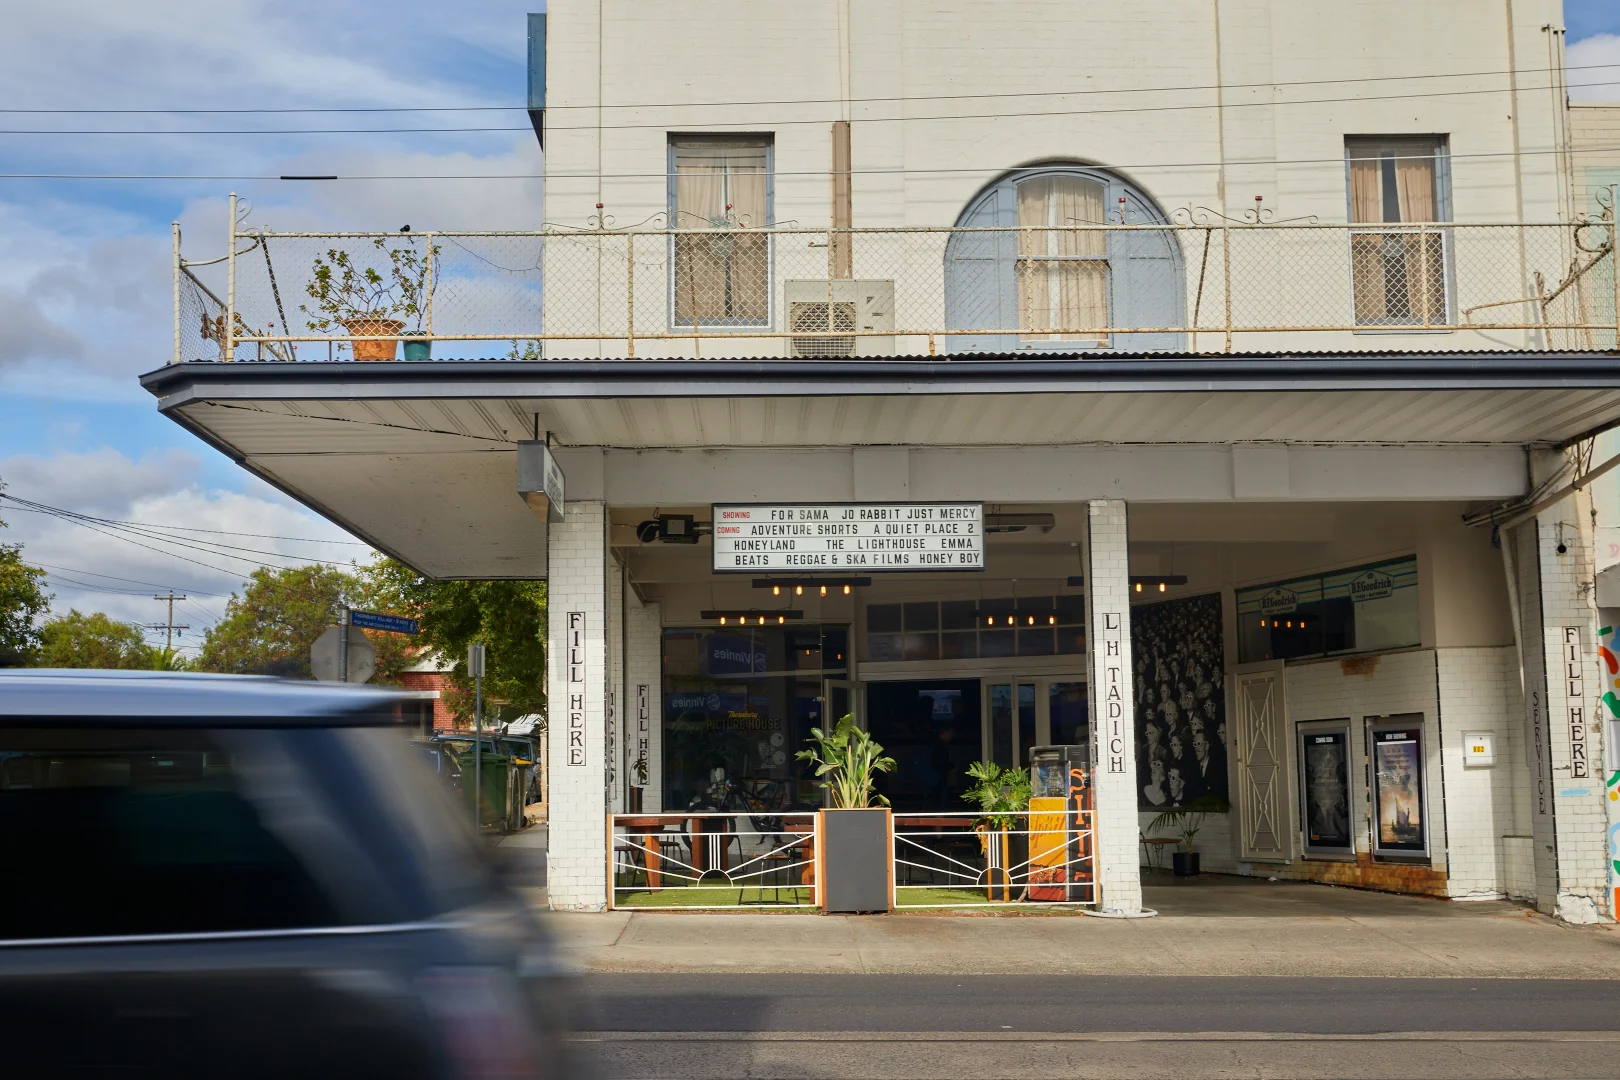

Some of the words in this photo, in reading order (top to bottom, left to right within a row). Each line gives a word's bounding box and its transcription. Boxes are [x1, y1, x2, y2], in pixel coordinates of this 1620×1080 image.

[751, 525, 812, 535] ADVENTURE
[818, 524, 858, 534] SHORTS
[874, 524, 880, 534] A
[886, 524, 918, 534] QUIET
[925, 524, 958, 534] PLACE
[968, 523, 974, 534] 2
[771, 510, 793, 520] FOR
[800, 510, 829, 520] SAMA
[842, 510, 854, 519] JO
[860, 509, 900, 520] RABBIT
[907, 508, 933, 519] JUST
[940, 508, 976, 519] MERCY
[734, 539, 795, 550] HONEYLAND
[827, 539, 844, 550] THE
[858, 538, 926, 549] LIGHTHOUSE
[941, 538, 973, 549] EMMA
[735, 555, 769, 565] BEATS
[786, 554, 826, 565] REGGAE
[832, 555, 838, 564] &
[846, 554, 866, 564] SKA
[873, 554, 909, 564] FILMS
[919, 553, 953, 564] HONEY
[960, 553, 980, 563] BOY
[570, 613, 583, 682] FILL
[1565, 627, 1581, 697] FILL
[570, 695, 583, 765] HERE
[639, 686, 648, 731] FILL
[749, 718, 781, 730] HOUSE
[1533, 691, 1546, 814] SERVICE
[1570, 708, 1586, 777] HERE
